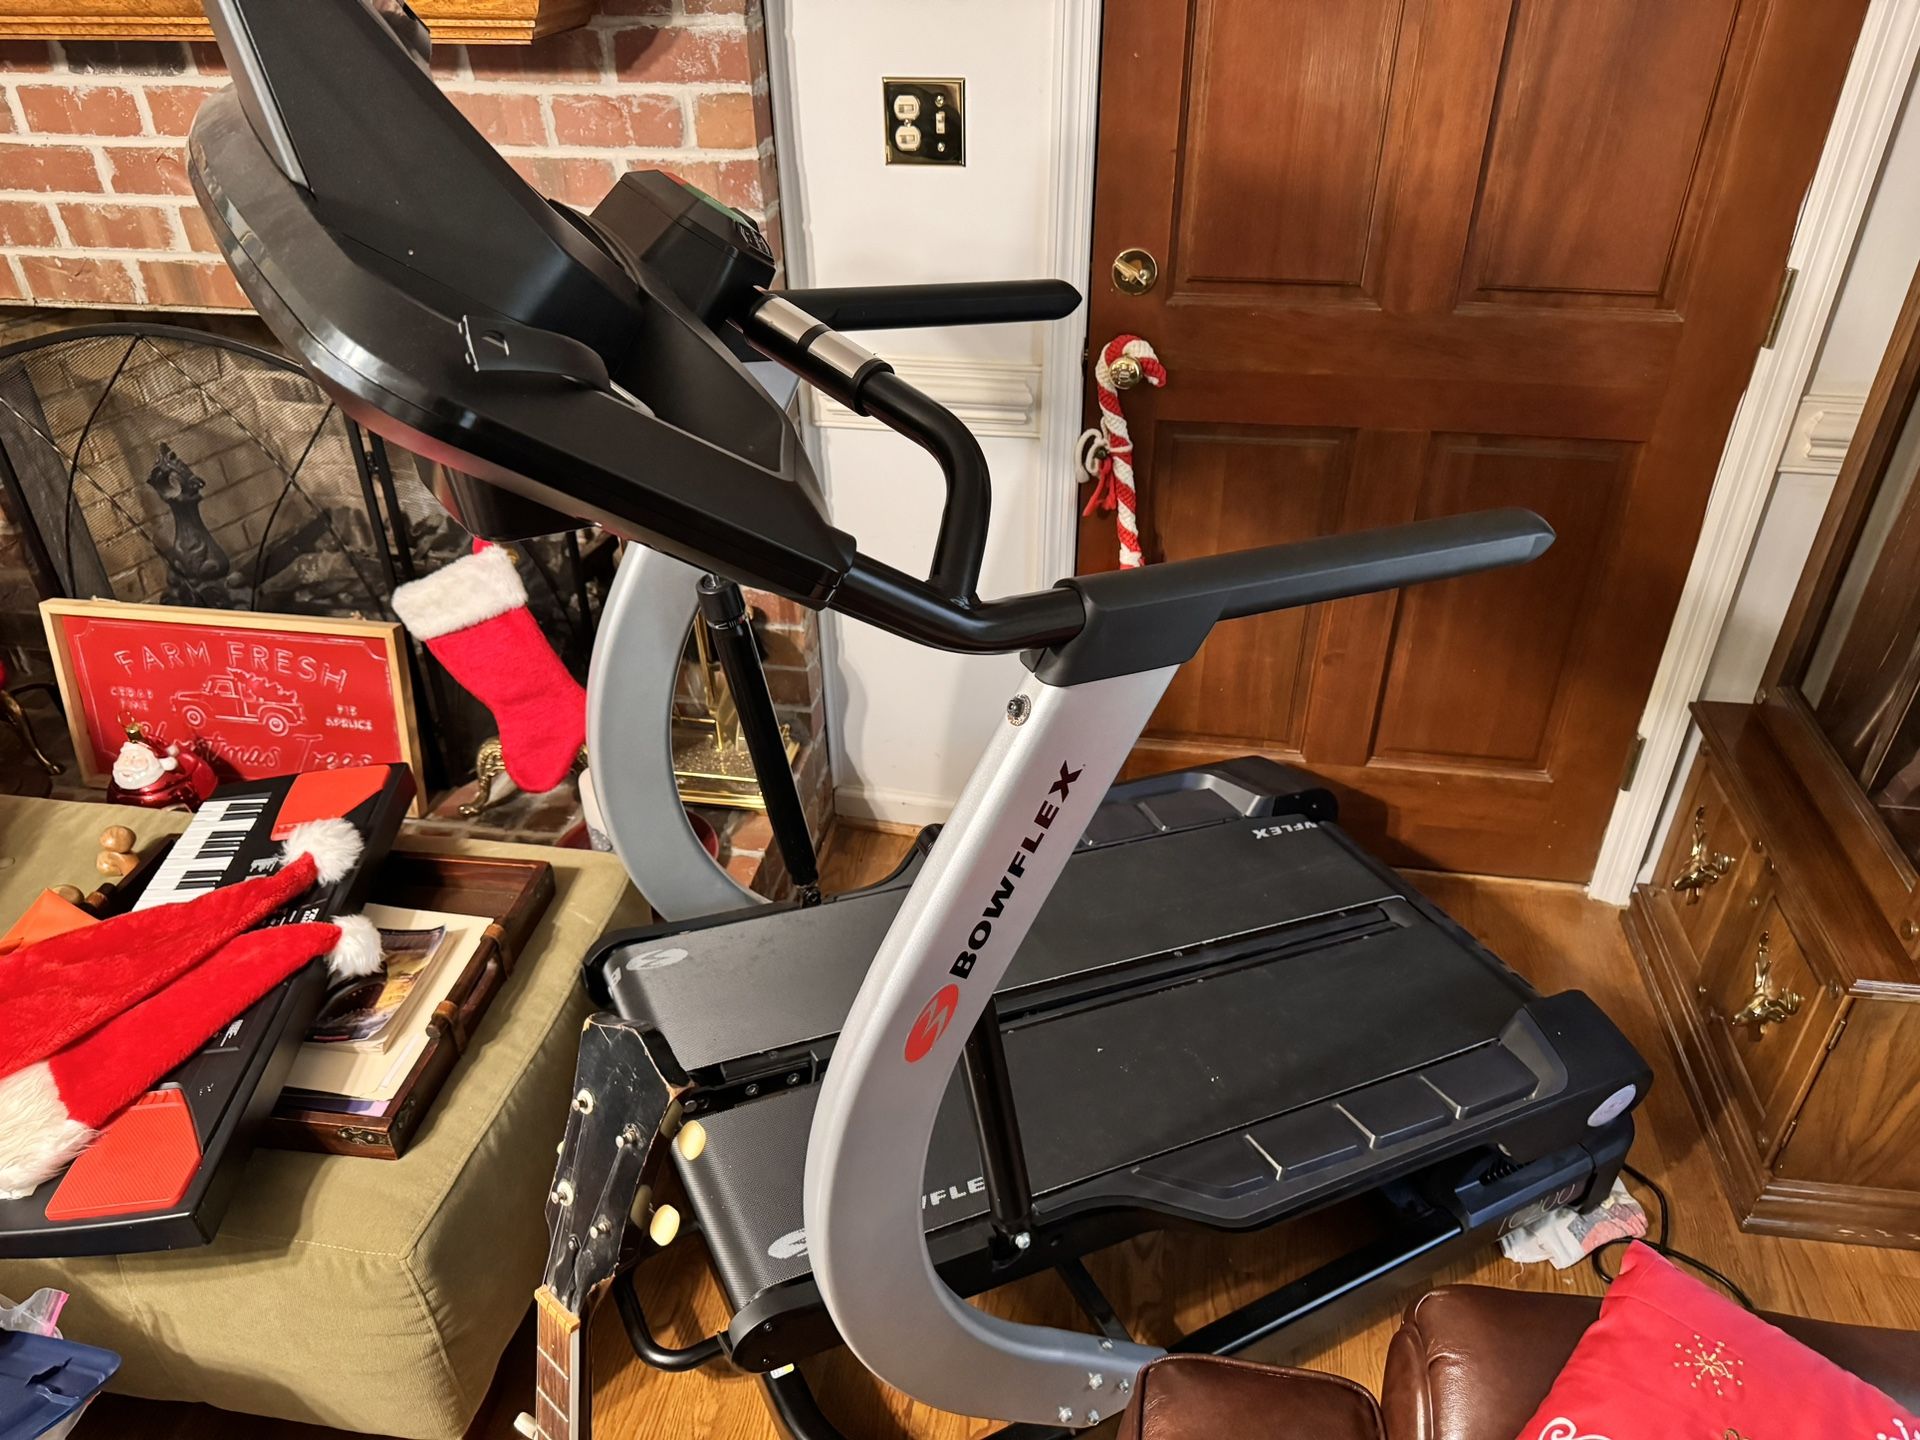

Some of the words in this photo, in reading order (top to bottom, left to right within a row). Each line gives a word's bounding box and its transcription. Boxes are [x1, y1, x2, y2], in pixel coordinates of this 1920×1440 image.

[113, 640, 211, 678] FARM
[226, 640, 348, 693] FRESH
[949, 759, 1083, 980] BOWFLEX
[921, 1176, 986, 1210] FLE
